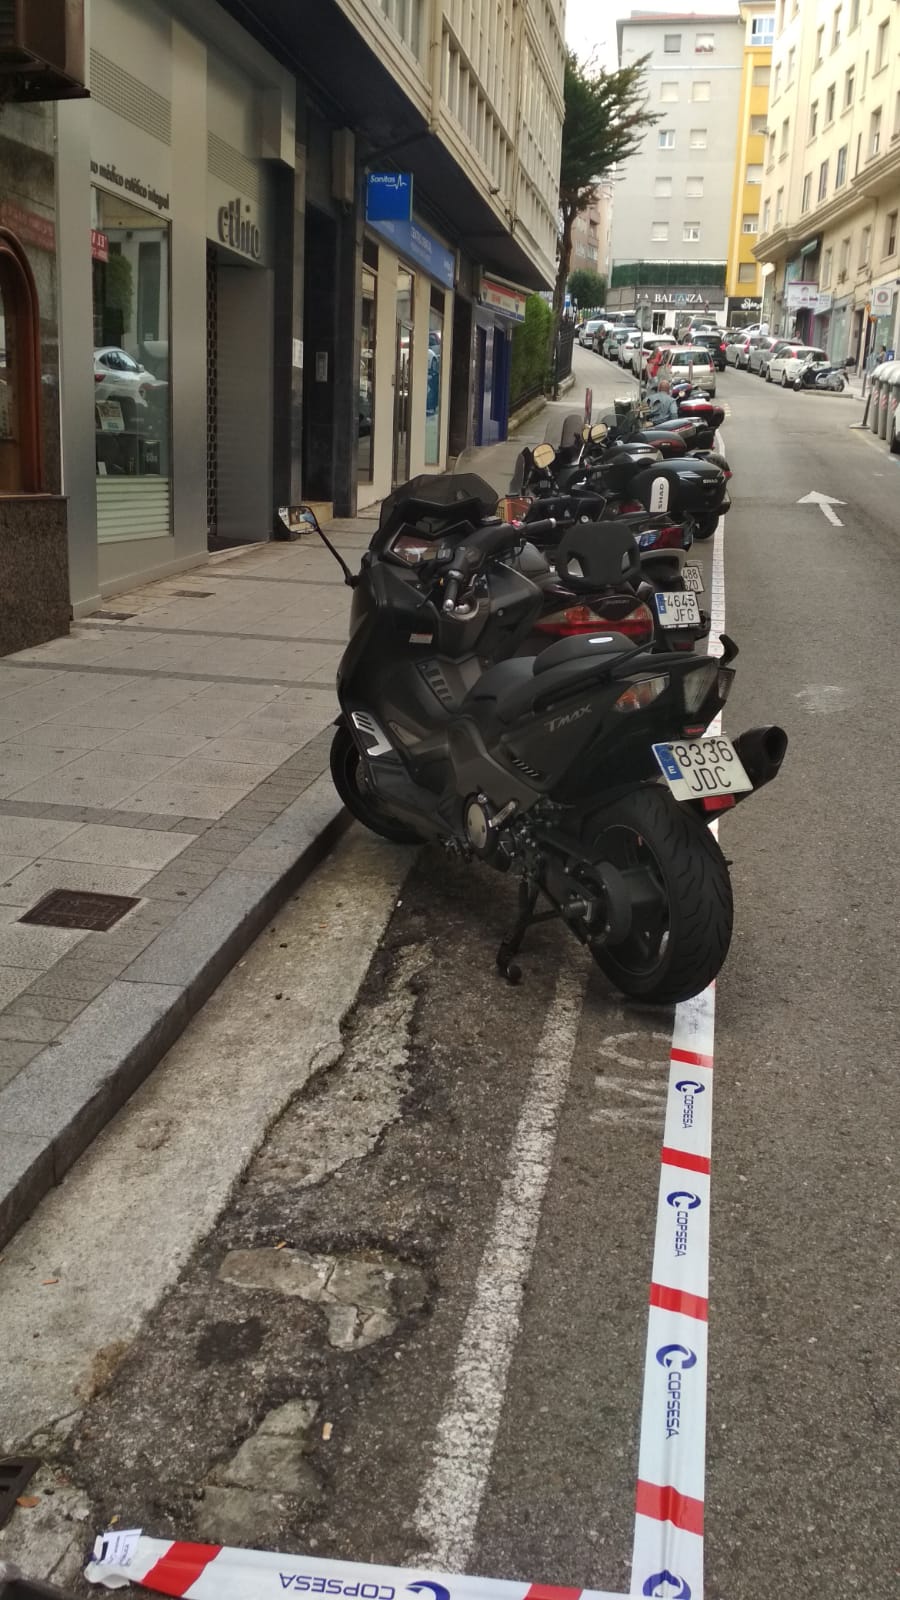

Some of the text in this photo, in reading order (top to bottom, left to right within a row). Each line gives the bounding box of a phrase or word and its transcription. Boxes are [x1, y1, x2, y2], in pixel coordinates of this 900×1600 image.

[370, 174, 396, 183] Sanitas
[654, 292, 704, 303] BALNZA
[667, 594, 695, 608] 4645
[674, 608, 695, 622] JFG
[675, 740, 734, 767] 8336
[691, 766, 731, 791] JDC
[682, 1094, 694, 1129] COPSESA
[674, 1210, 689, 1257] COPSESA
[665, 1371, 682, 1440] COPSESA
[279, 1573, 396, 1600] COPSESA
